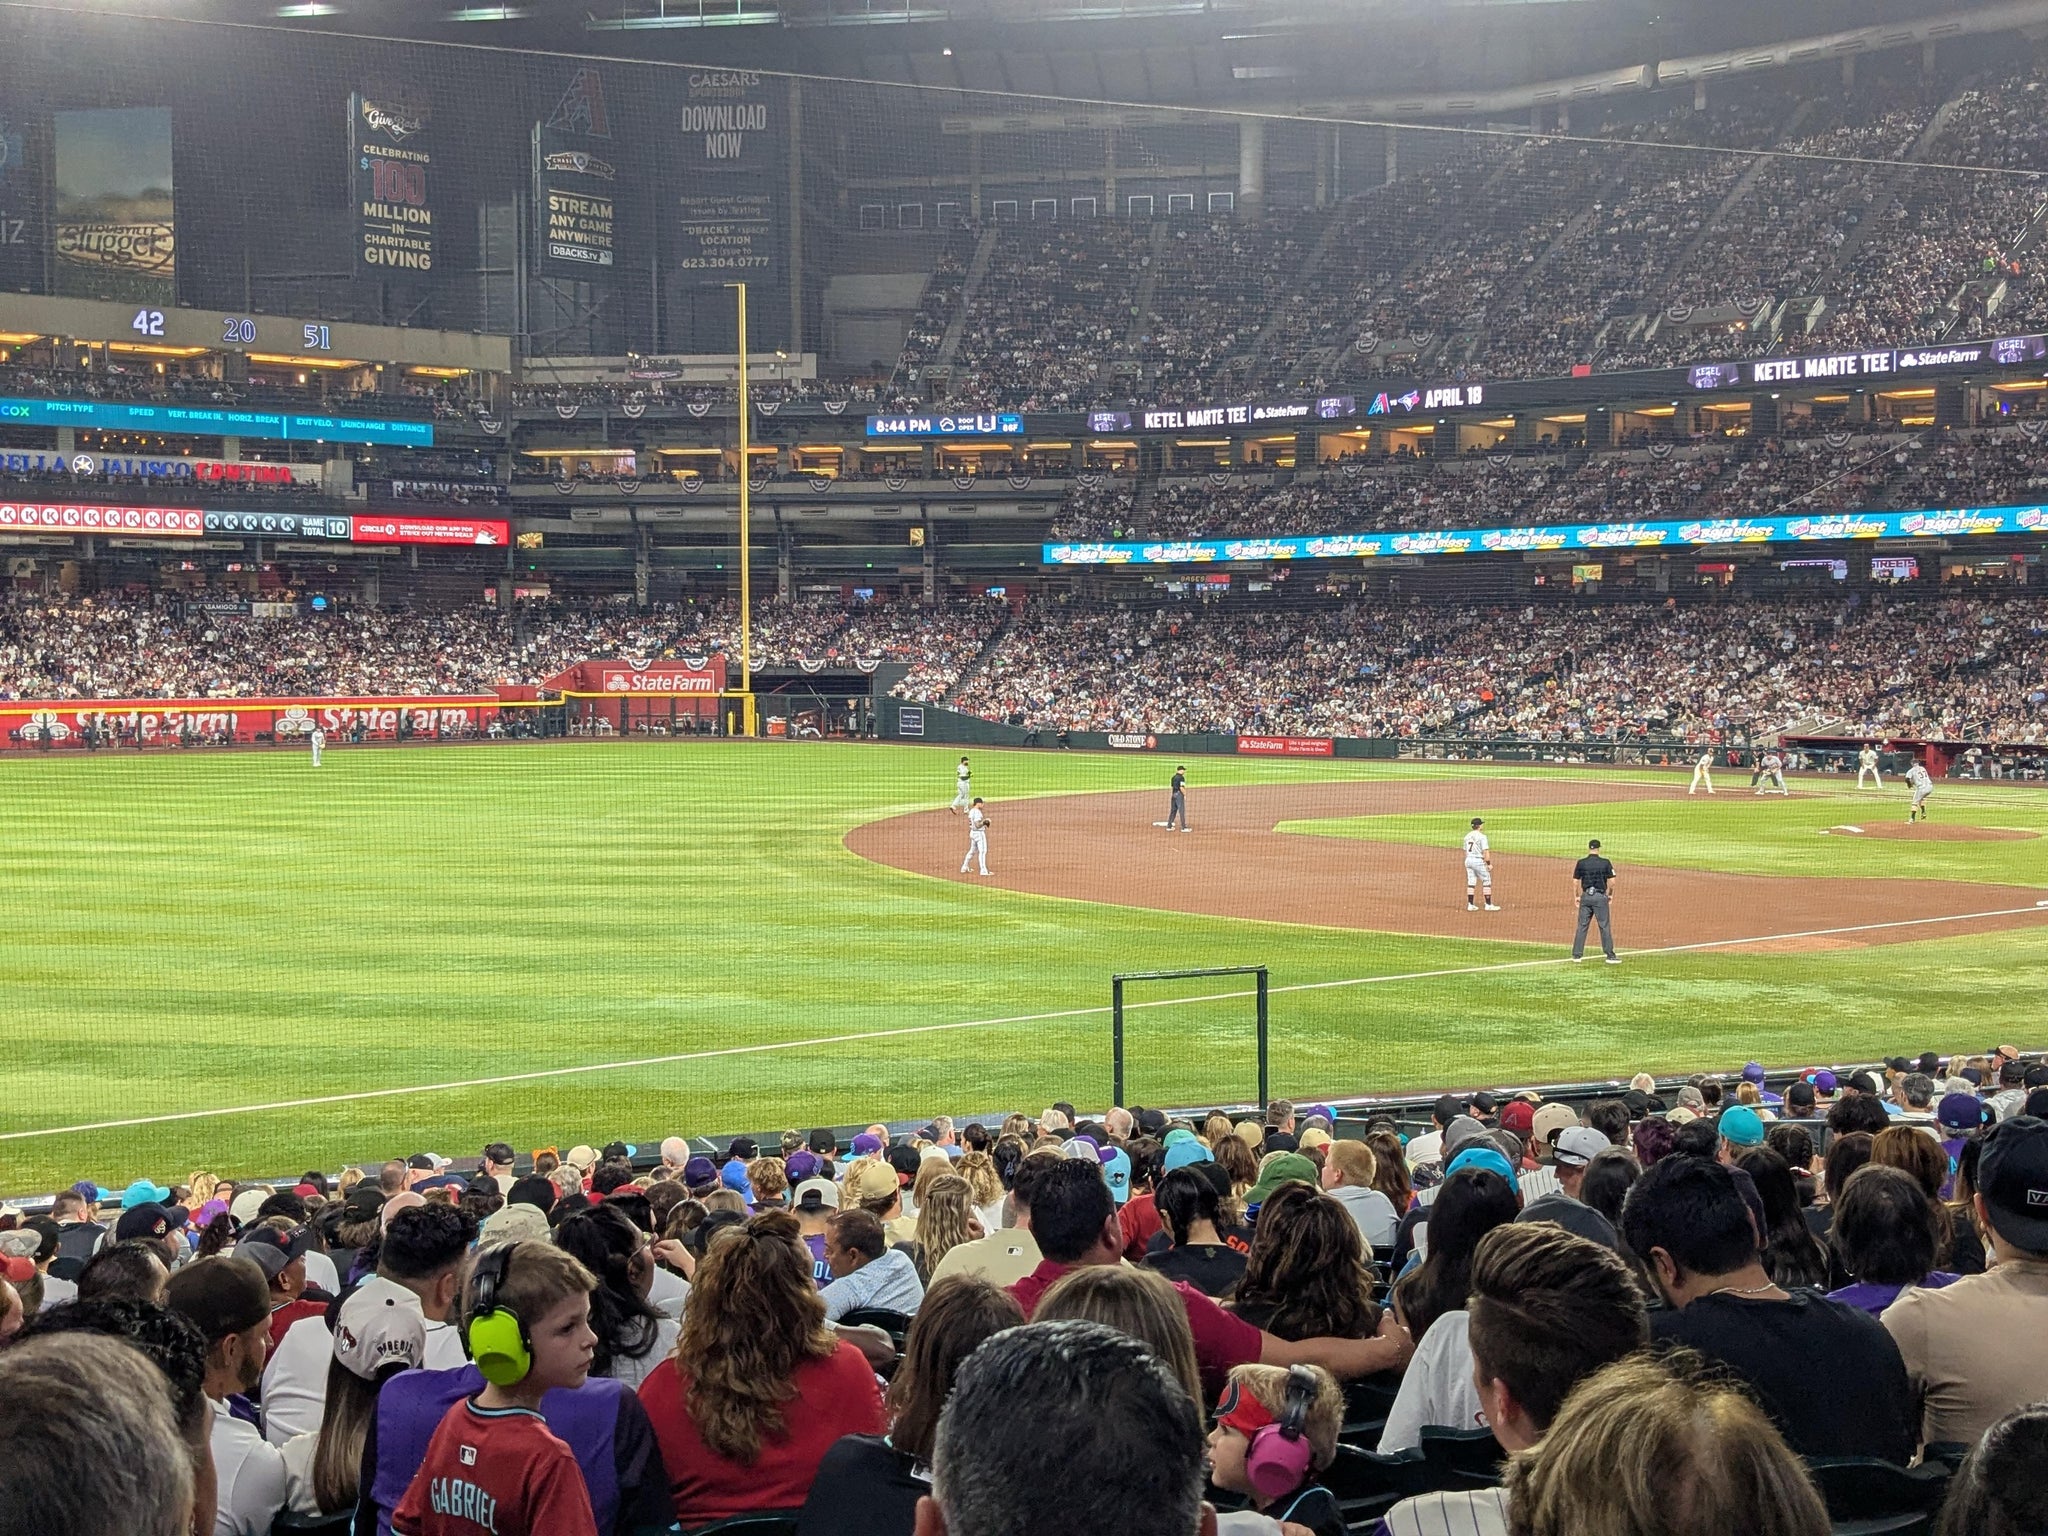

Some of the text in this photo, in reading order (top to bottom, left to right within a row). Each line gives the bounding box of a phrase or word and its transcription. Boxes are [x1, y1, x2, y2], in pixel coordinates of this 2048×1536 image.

[689, 74, 760, 88] CAESARS
[682, 104, 767, 132] DOWNLOAD
[706, 132, 742, 159] NOW
[363, 145, 430, 163] CELEBRATING
[363, 202, 431, 224] MILLION
[549, 196, 613, 219] STREAM
[392, 224, 404, 234] IN
[549, 214, 613, 234] ANY GAME
[364, 234, 431, 251] CHARITABLE
[549, 228, 613, 247] ANYWHERE
[701, 236, 750, 245] LOCATION
[364, 247, 432, 270] GIVING
[682, 257, 769, 269] 623.304.0777
[132, 310, 165, 336] 42
[223, 318, 256, 343] 20
[304, 324, 331, 350] 51
[1754, 353, 1890, 382] KETEL MARTE TEE
[1424, 386, 1482, 409] APRIL 18
[1, 405, 30, 417] COX
[46, 403, 94, 413] PITCH TYPE
[129, 407, 154, 417] SPEED
[168, 409, 188, 419] VERT.
[189, 411, 212, 420] BREAK
[228, 413, 280, 424] HORIZ. BREAK
[296, 417, 334, 428] EXIT VELO.
[1144, 406, 1247, 429] KETEL MARTE TEE
[341, 420, 386, 431] LAUNCH ANGLE
[391, 423, 426, 433] DISTANCE
[876, 419, 931, 433] 8:44 PM
[302, 517, 325, 527] GAME
[329, 521, 346, 534] 10
[359, 525, 384, 533] CIRCLE
[1923, 518, 1957, 532] Baja
[1959, 516, 2004, 529] Blast
[302, 527, 325, 536] TOTAL
[1809, 520, 1887, 541] Baja Blast
[1468, 841, 1474, 852] 7
[431, 1477, 498, 1536] GABRIEL
